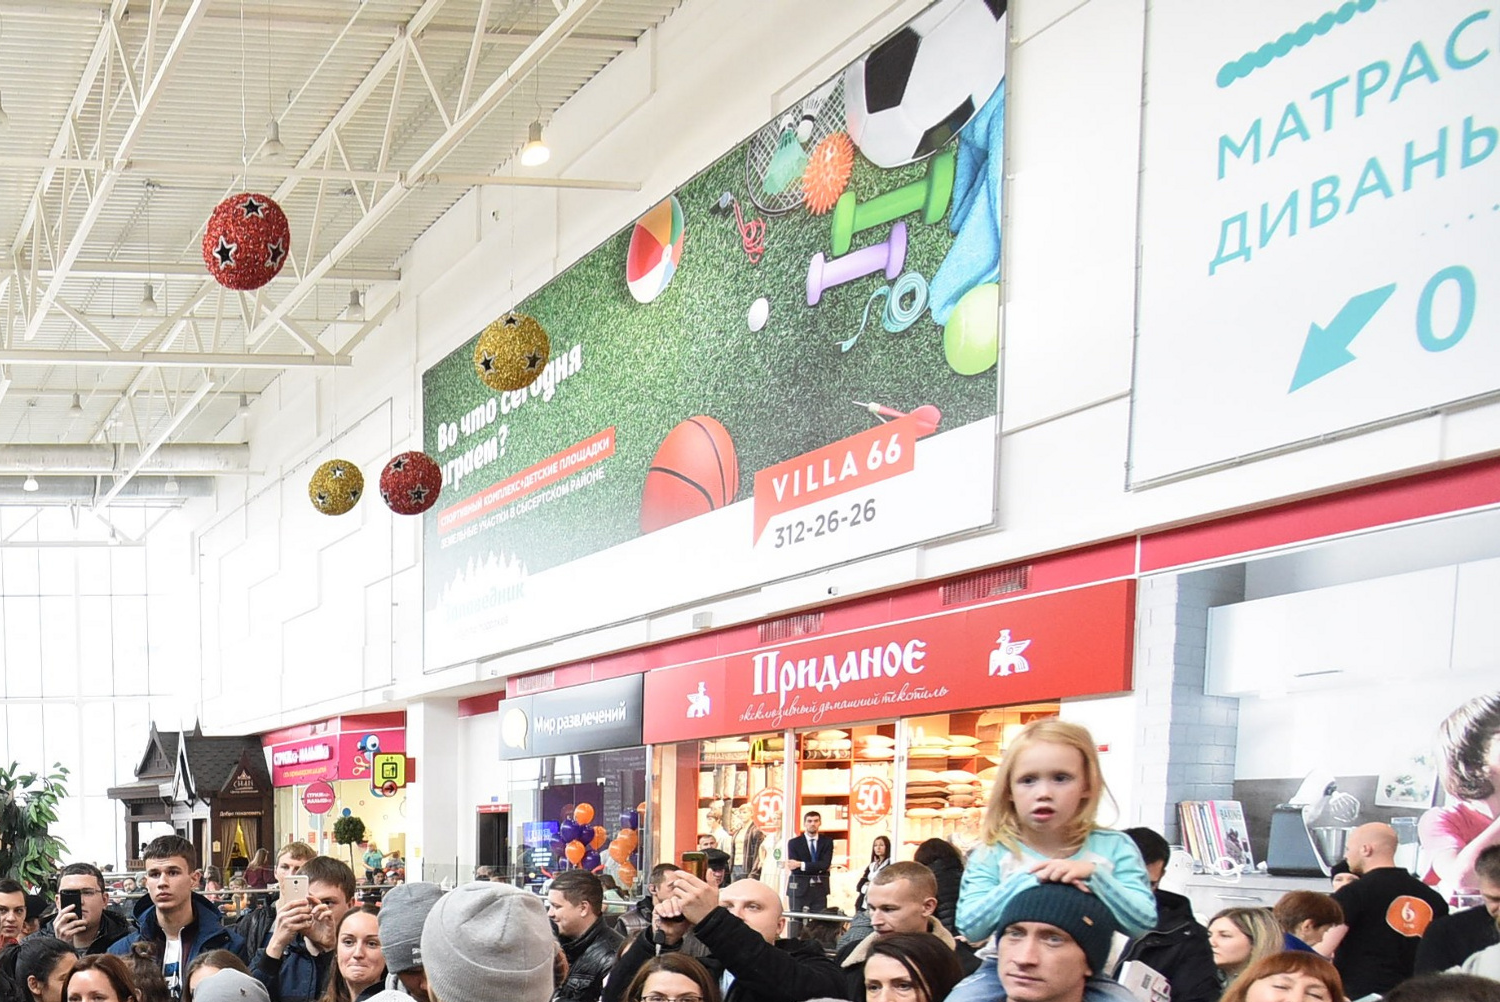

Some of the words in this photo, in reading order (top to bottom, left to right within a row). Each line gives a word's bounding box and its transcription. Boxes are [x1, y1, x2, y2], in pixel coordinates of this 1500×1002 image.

[1217, 9, 1500, 181] МАТРАС
[437, 422, 458, 453] Во
[460, 397, 497, 436] что
[558, 436, 610, 473] ПЛОЩАДКИ
[771, 456, 859, 503] VILLA
[865, 440, 903, 481] 66
[478, 510, 510, 537] УЧАСТКИ
[569, 465, 606, 494] РАЙОНЕ
[773, 498, 877, 549] 312-26-26
[751, 638, 928, 707] Приданое
[533, 714, 556, 735] Мир
[557, 700, 627, 735] развлечений
[738, 694, 818, 729] эксклюзивный
[813, 692, 881, 723] домашний
[881, 682, 950, 705] текстиль
